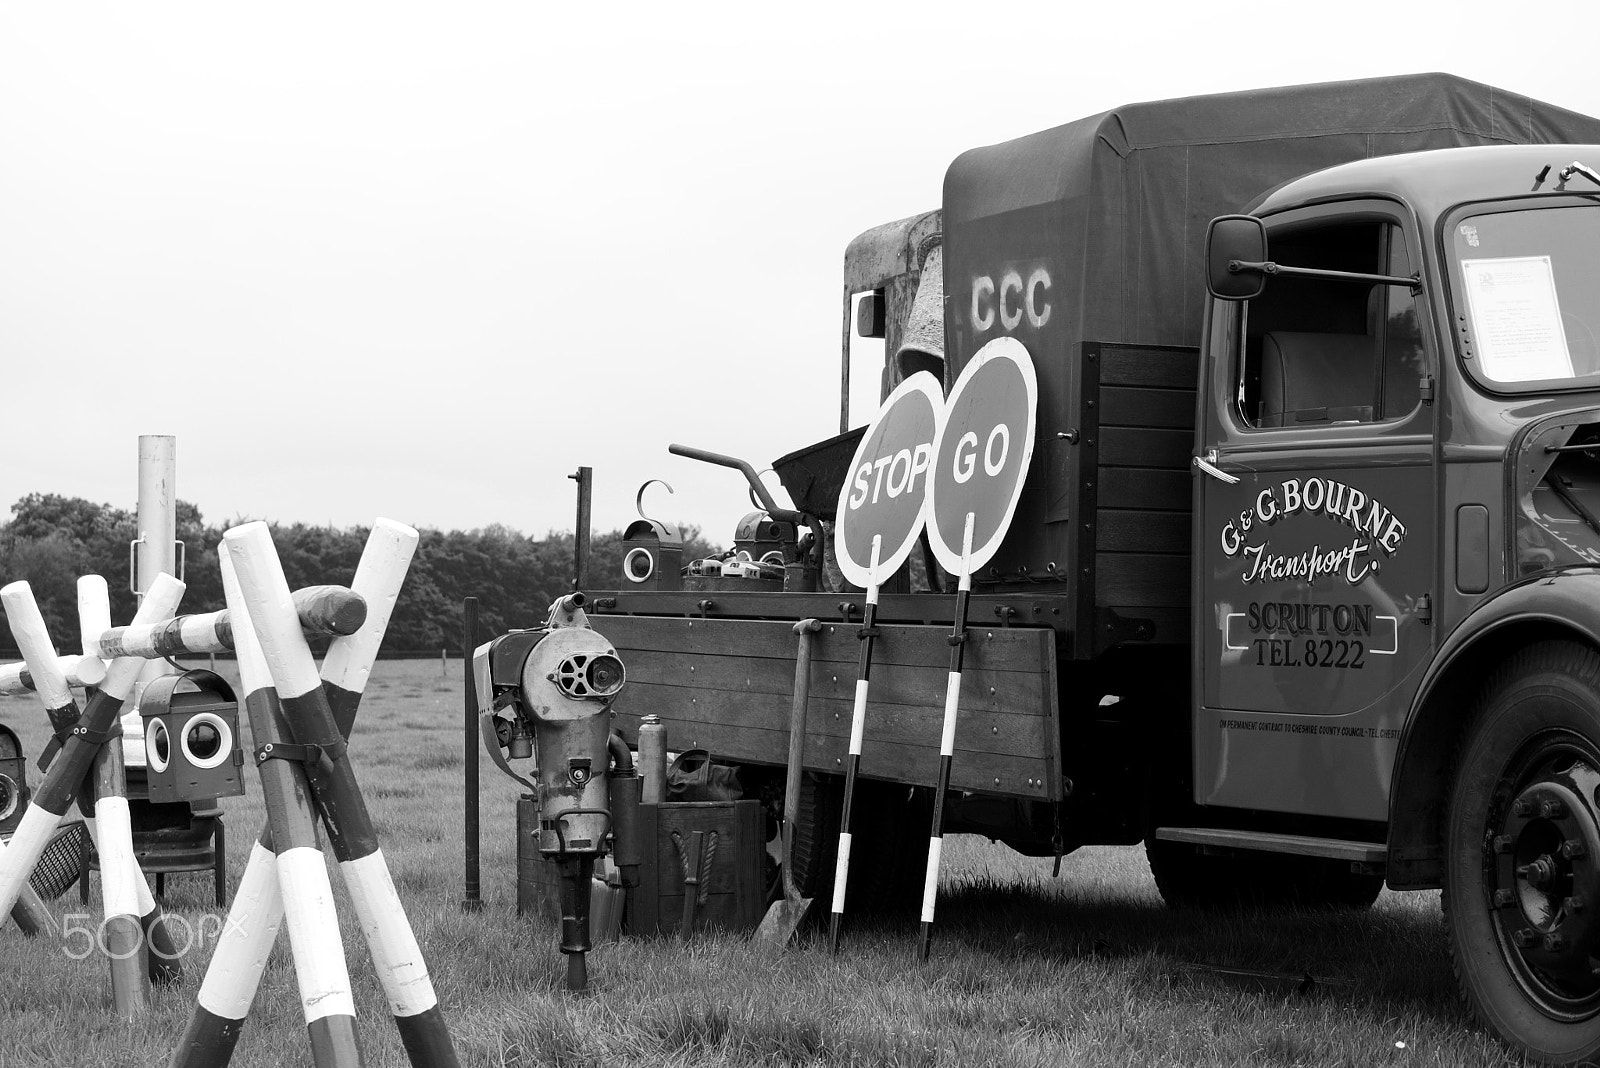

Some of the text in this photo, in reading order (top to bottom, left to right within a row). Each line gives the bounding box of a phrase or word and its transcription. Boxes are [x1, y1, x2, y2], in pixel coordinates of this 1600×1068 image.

[971, 268, 1051, 331] CCC
[850, 443, 932, 510] STOP
[953, 424, 1009, 483] GO
[1240, 508, 1253, 532] &
[1281, 477, 1406, 553] BOURNE
[1248, 602, 1371, 636] SCRUTON
[1304, 640, 1364, 669] 8222
[1219, 719, 1227, 729] ON
[1227, 720, 1258, 731] PERMANENT
[1258, 722, 1284, 732] CONTRACT
[1284, 723, 1291, 733] TO
[1291, 724, 1318, 735] CHESHIRE
[1319, 725, 1341, 736] COUNTY
[1341, 726, 1365, 737] COUNCIL
